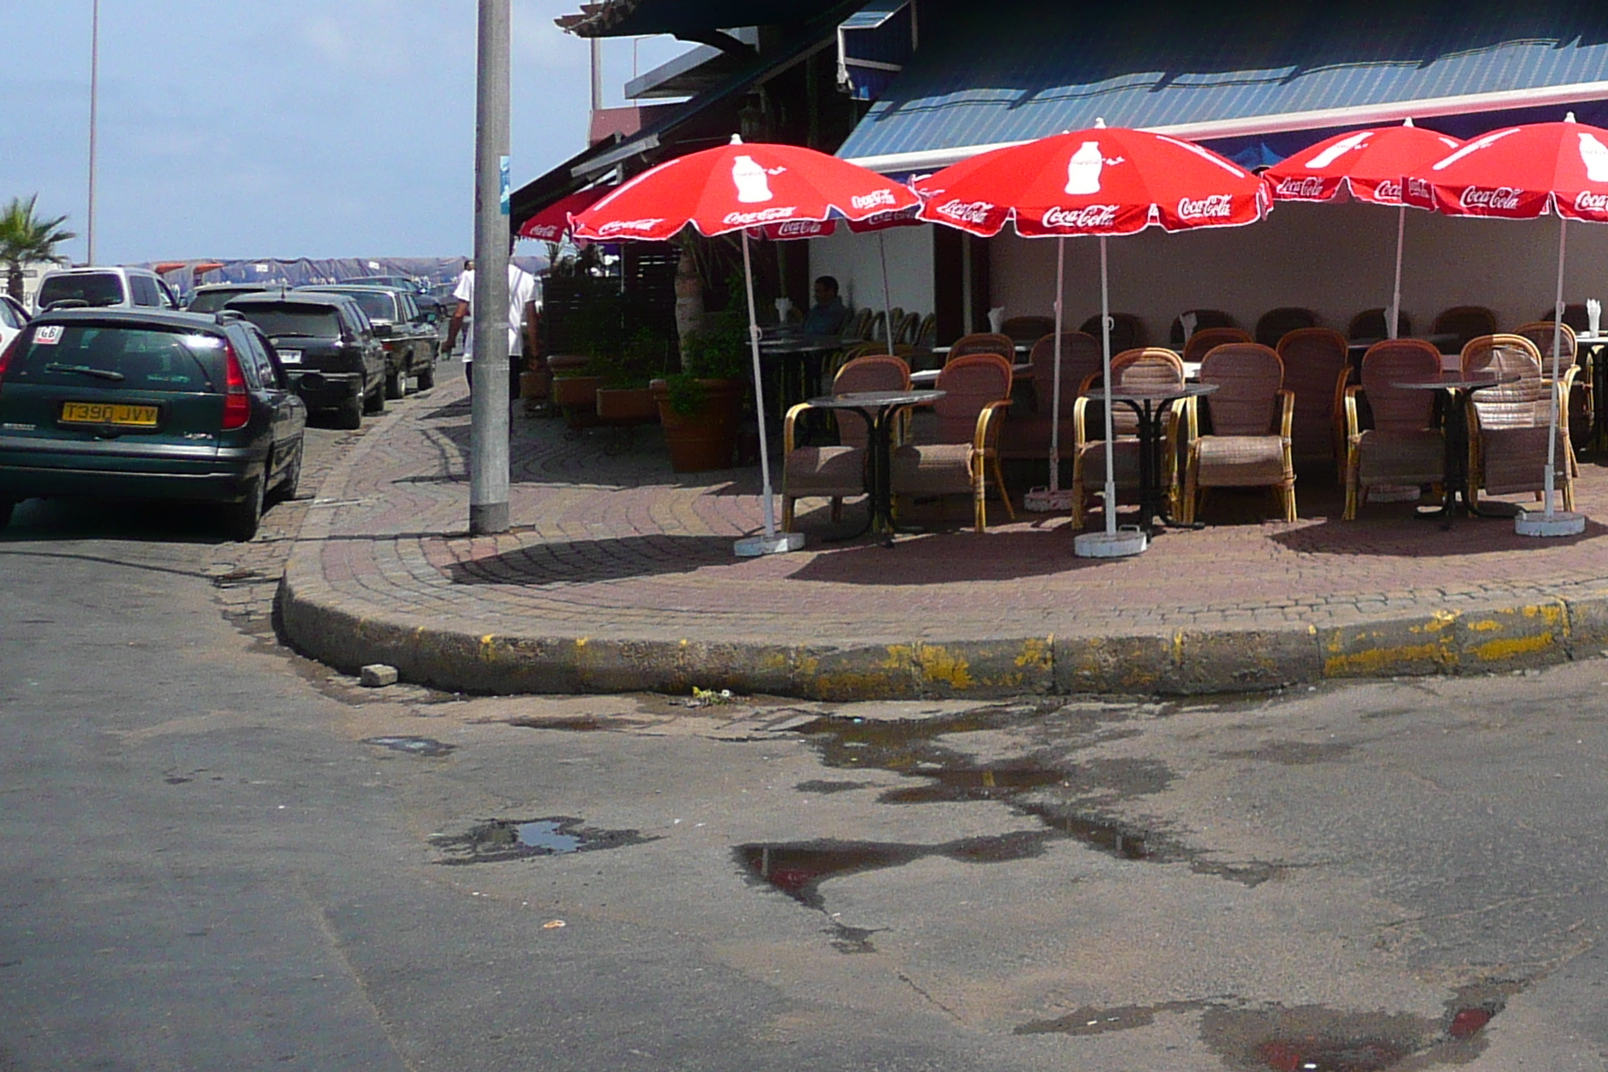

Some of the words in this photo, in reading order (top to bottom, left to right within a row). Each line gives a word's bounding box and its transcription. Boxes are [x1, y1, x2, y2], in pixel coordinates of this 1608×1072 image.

[1276, 177, 1325, 196] Coca-Cola
[1178, 194, 1233, 219] Coca-Cola
[1460, 185, 1524, 209] Coca-Cola
[1042, 205, 1120, 227] Coca-Cola
[41, 327, 56, 338] GB
[66, 405, 114, 421] T390
[119, 406, 155, 422] JVV
